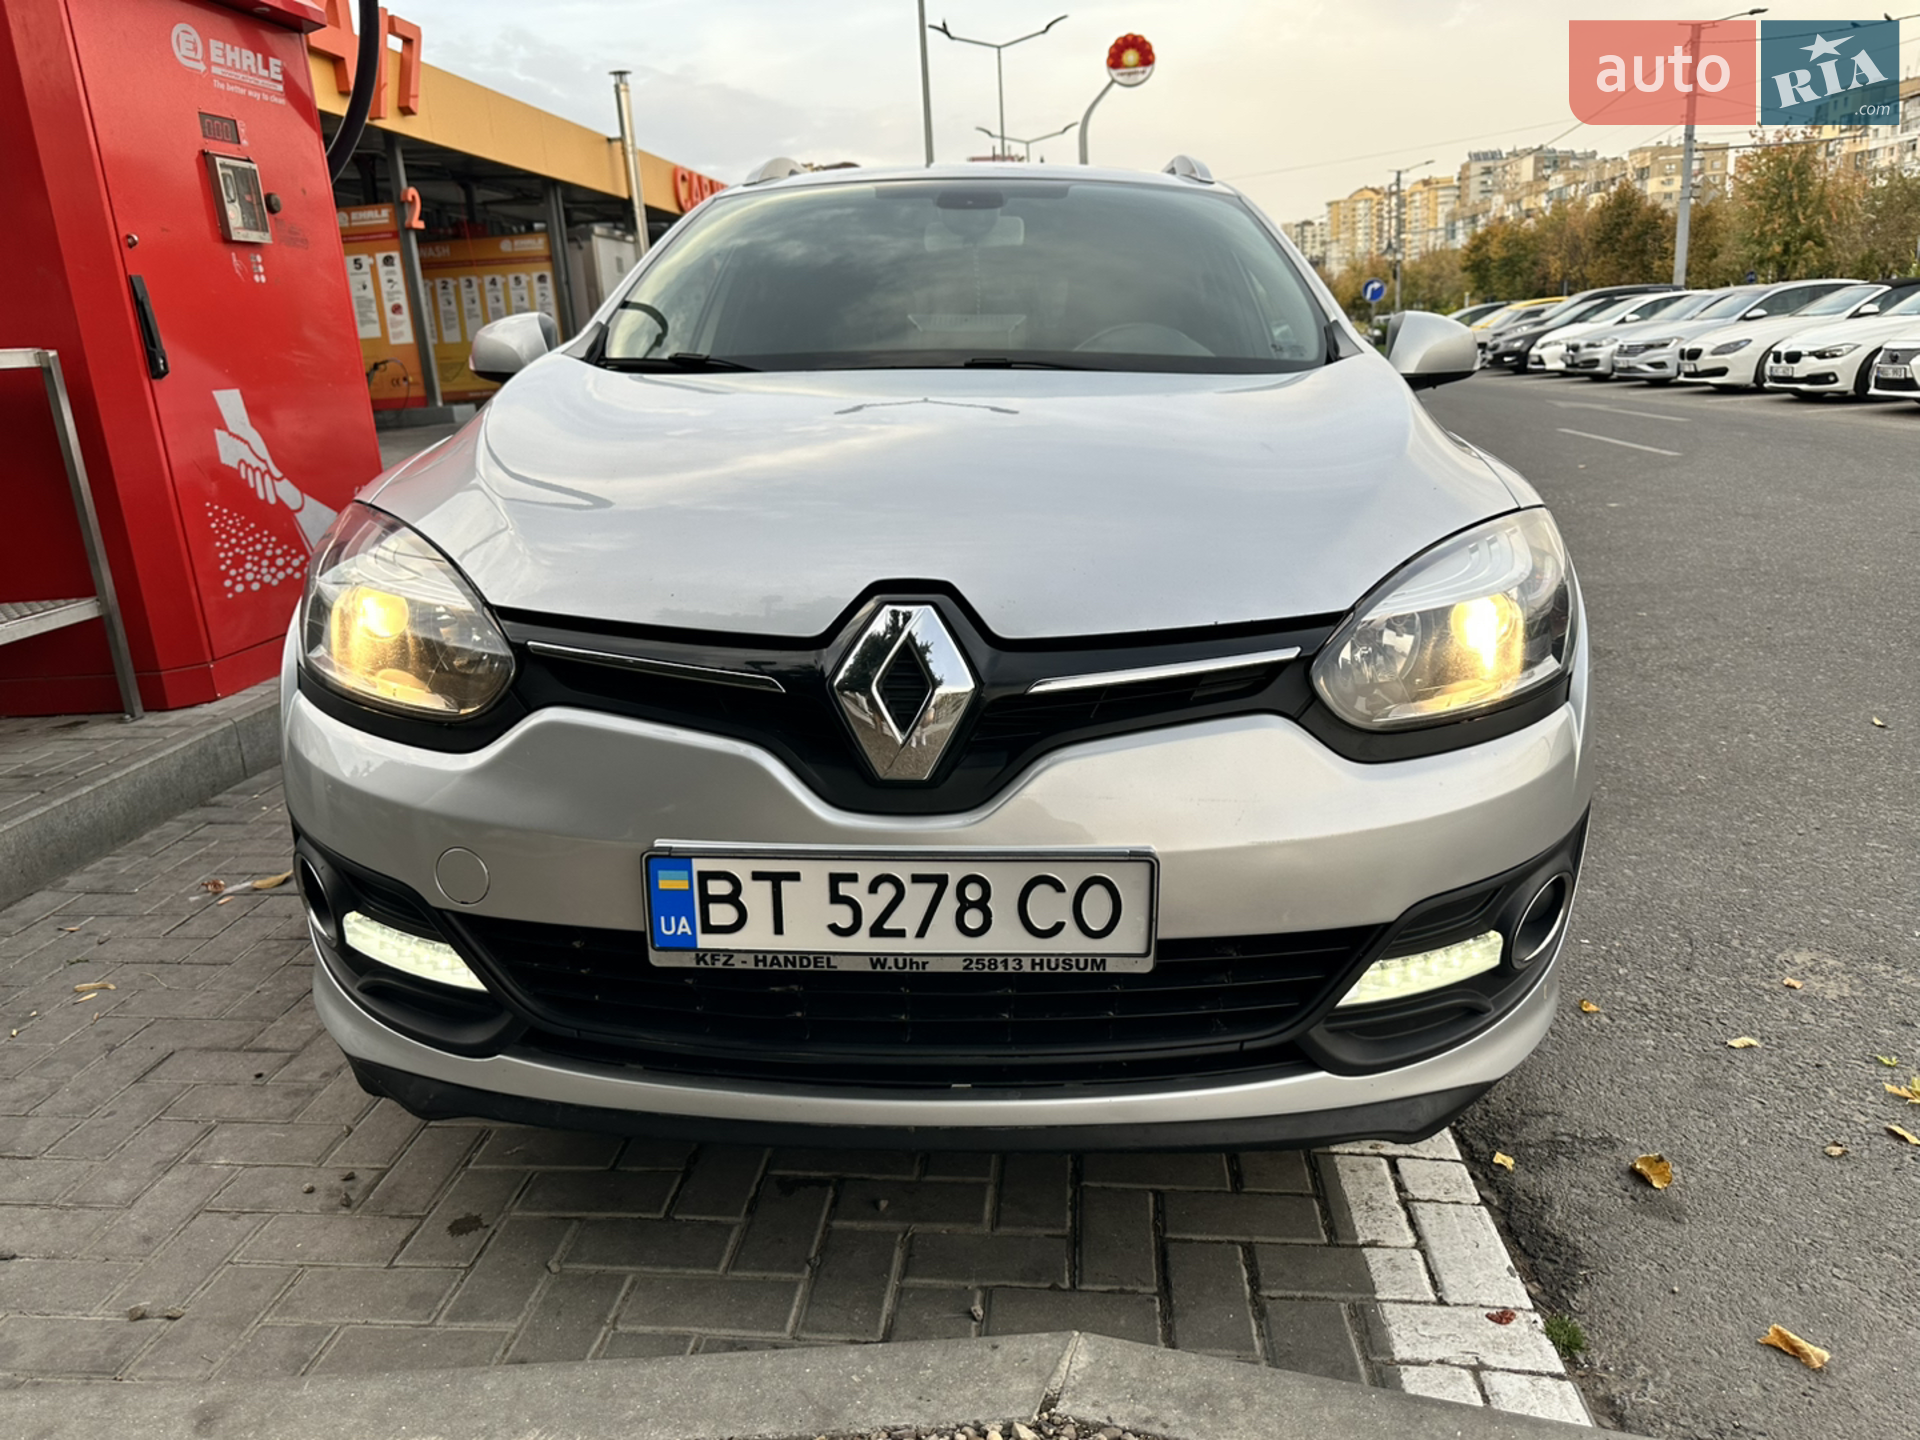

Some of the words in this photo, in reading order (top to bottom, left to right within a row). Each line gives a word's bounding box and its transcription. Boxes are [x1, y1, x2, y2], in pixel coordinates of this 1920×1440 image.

[208, 38, 284, 81] EHRLE
[213, 79, 225, 91] The
[226, 82, 246, 96] better
[248, 89, 260, 102] way
[270, 94, 286, 106] clean
[402, 186, 426, 230] 2
[353, 258, 363, 271] 5
[441, 280, 449, 291] 2
[465, 278, 473, 290] 3
[489, 277, 498, 288] 4
[697, 870, 802, 936] BT
[827, 871, 994, 939] 5278
[1017, 873, 1123, 940] CO
[660, 915, 692, 936] UA
[694, 952, 735, 968] KFZ
[753, 954, 838, 970] HANDEL
[869, 957, 930, 971] W.Uhr
[961, 957, 1024, 972] 25813
[1030, 957, 1107, 972] HUSUM
